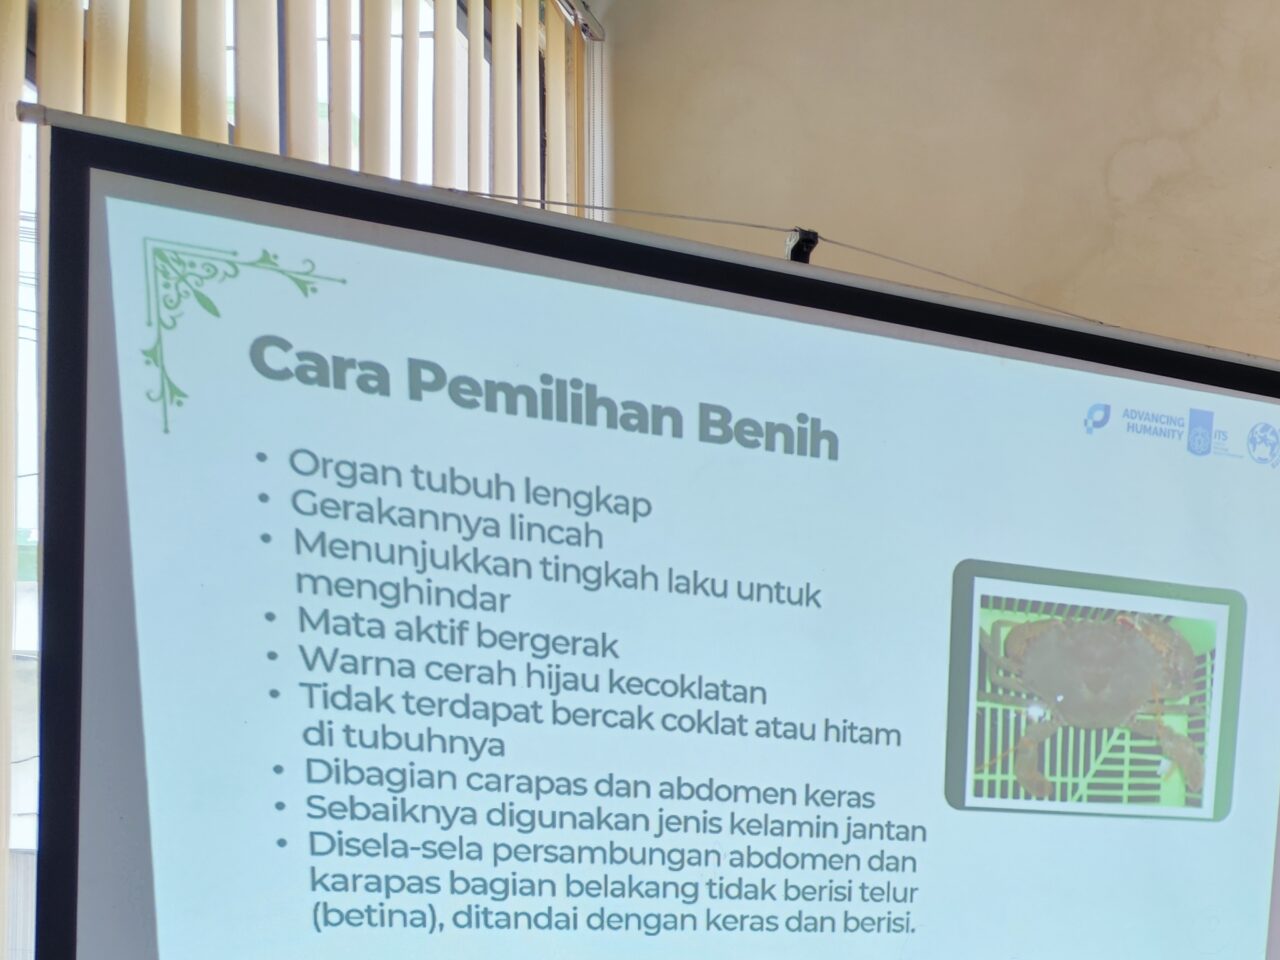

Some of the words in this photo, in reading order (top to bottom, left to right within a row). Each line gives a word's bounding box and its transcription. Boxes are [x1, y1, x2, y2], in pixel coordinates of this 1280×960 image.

[248, 334, 391, 398] Cara
[407, 357, 684, 439] Pemilihan
[698, 401, 839, 462] Benih
[1122, 408, 1185, 427] ADVANCING
[1126, 422, 1185, 440] HUMANITY
[288, 447, 403, 489] Organ
[410, 464, 516, 503] tubuh
[524, 476, 653, 524] lengkap
[290, 488, 501, 543] Gerakannya
[509, 512, 604, 550] lincah
[294, 527, 533, 580] Menunjukkan
[538, 554, 659, 593] tingkah
[667, 566, 729, 599] laku
[736, 580, 822, 609] untuk
[295, 572, 512, 614] menghindar
[298, 605, 386, 640] Mata
[394, 615, 470, 647] aktif
[476, 621, 620, 660] bergerak
[298, 644, 416, 680] Warna
[424, 659, 517, 688] cerah
[526, 661, 600, 697] hijau
[608, 667, 767, 706] kecoklatan
[298, 681, 396, 715] Tidak
[401, 690, 545, 728] terdapat
[551, 698, 656, 732] bercak
[660, 708, 749, 737] coklat
[754, 716, 817, 742] atau
[823, 717, 902, 747] hitam
[301, 719, 334, 748] di
[341, 723, 506, 763] tubuhnya
[305, 756, 457, 795] Dibagian
[465, 771, 589, 801] carapas
[593, 772, 652, 799] dan
[658, 775, 797, 807] abdomen
[804, 782, 876, 810] keras
[306, 794, 478, 832] Sebaiknya
[485, 801, 650, 835] digunakan
[653, 807, 723, 839] jenis
[729, 811, 839, 840] kelamin
[841, 815, 927, 846] jantan
[308, 829, 483, 862] Disela-sela
[492, 839, 722, 872] persambungan
[728, 844, 861, 872] abdomen
[867, 849, 917, 874] dan
[309, 865, 442, 900] karapas
[449, 869, 557, 902] bagian
[565, 872, 700, 906] belakang
[704, 875, 777, 902] tidak
[783, 877, 853, 903] berisi
[858, 880, 920, 904] telur
[312, 900, 445, 935] (betina),
[451, 903, 579, 931] ditandai
[585, 906, 698, 937] dengan
[705, 907, 780, 933] keras
[784, 909, 836, 934] dan
[843, 909, 916, 934] berisi.
